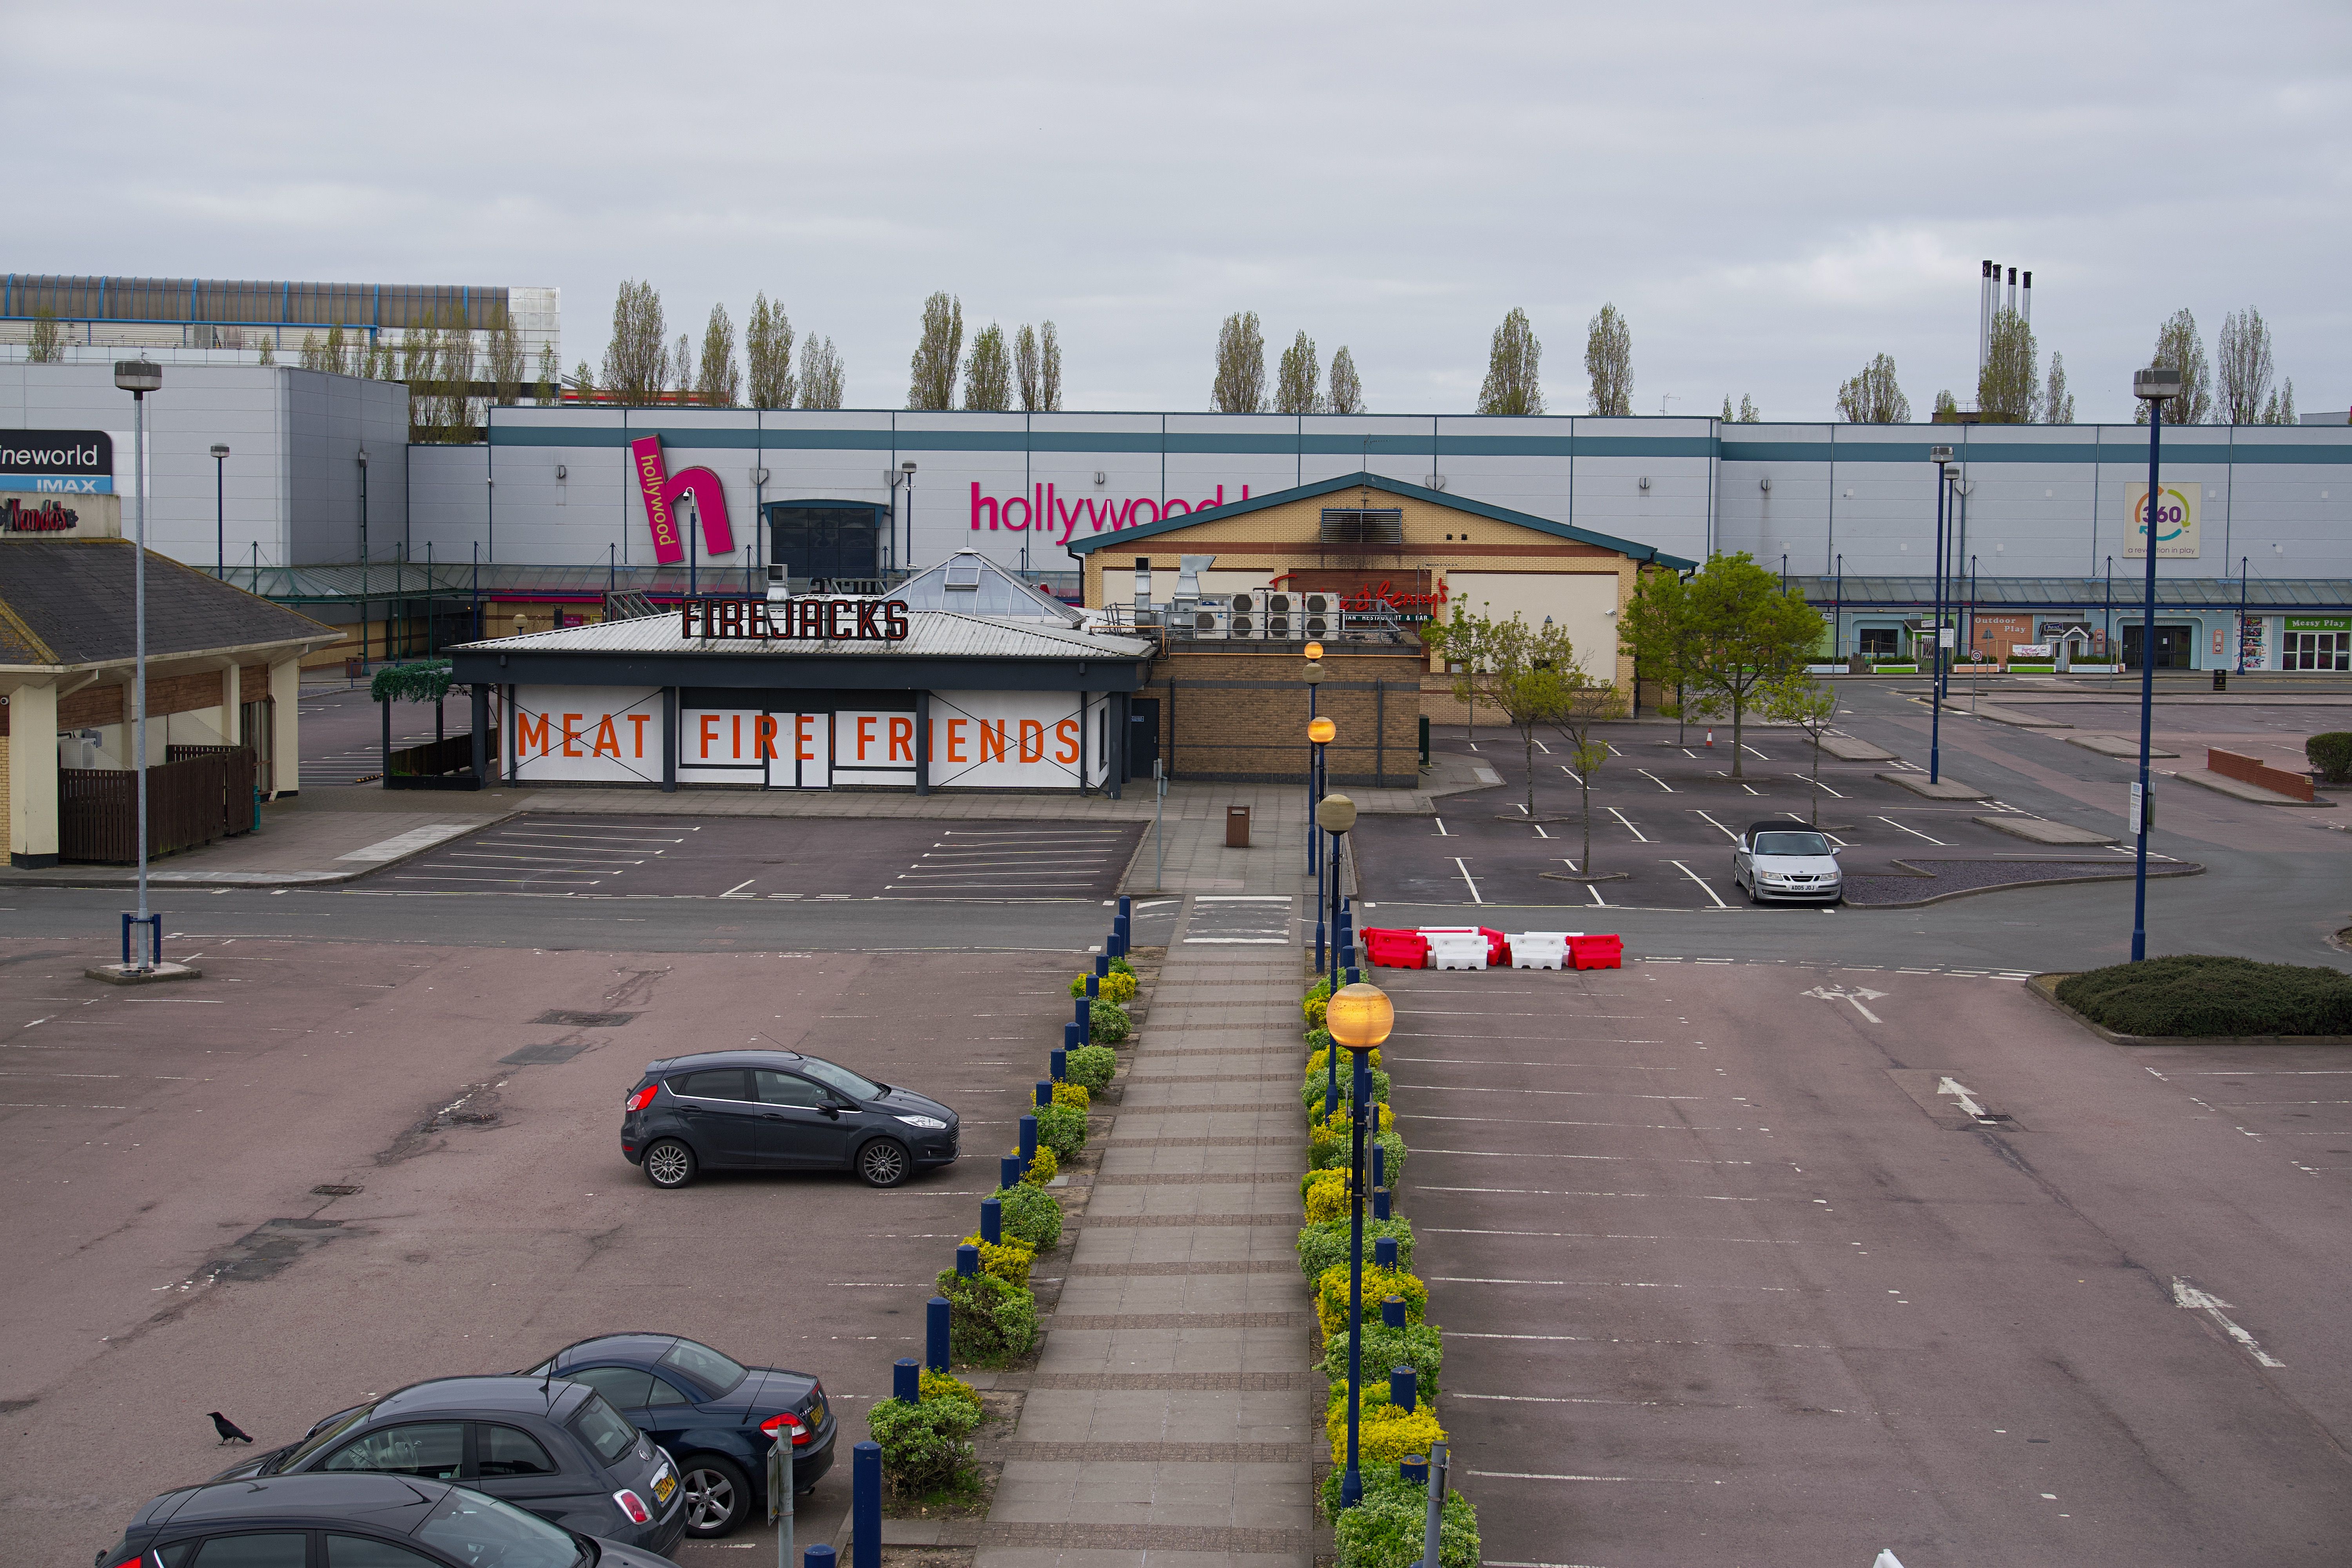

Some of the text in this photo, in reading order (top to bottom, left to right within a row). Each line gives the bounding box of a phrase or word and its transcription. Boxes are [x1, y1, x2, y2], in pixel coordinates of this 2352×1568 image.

[37, 479, 97, 492] IMAX
[641, 454, 676, 545] hollywood
[5, 498, 67, 531] Nando's
[682, 599, 909, 641] FIREJACKS
[2004, 625, 2026, 634] Play
[2292, 619, 2346, 628] Messy Play
[518, 713, 1080, 764] MEAT FIRE FRIENDS
